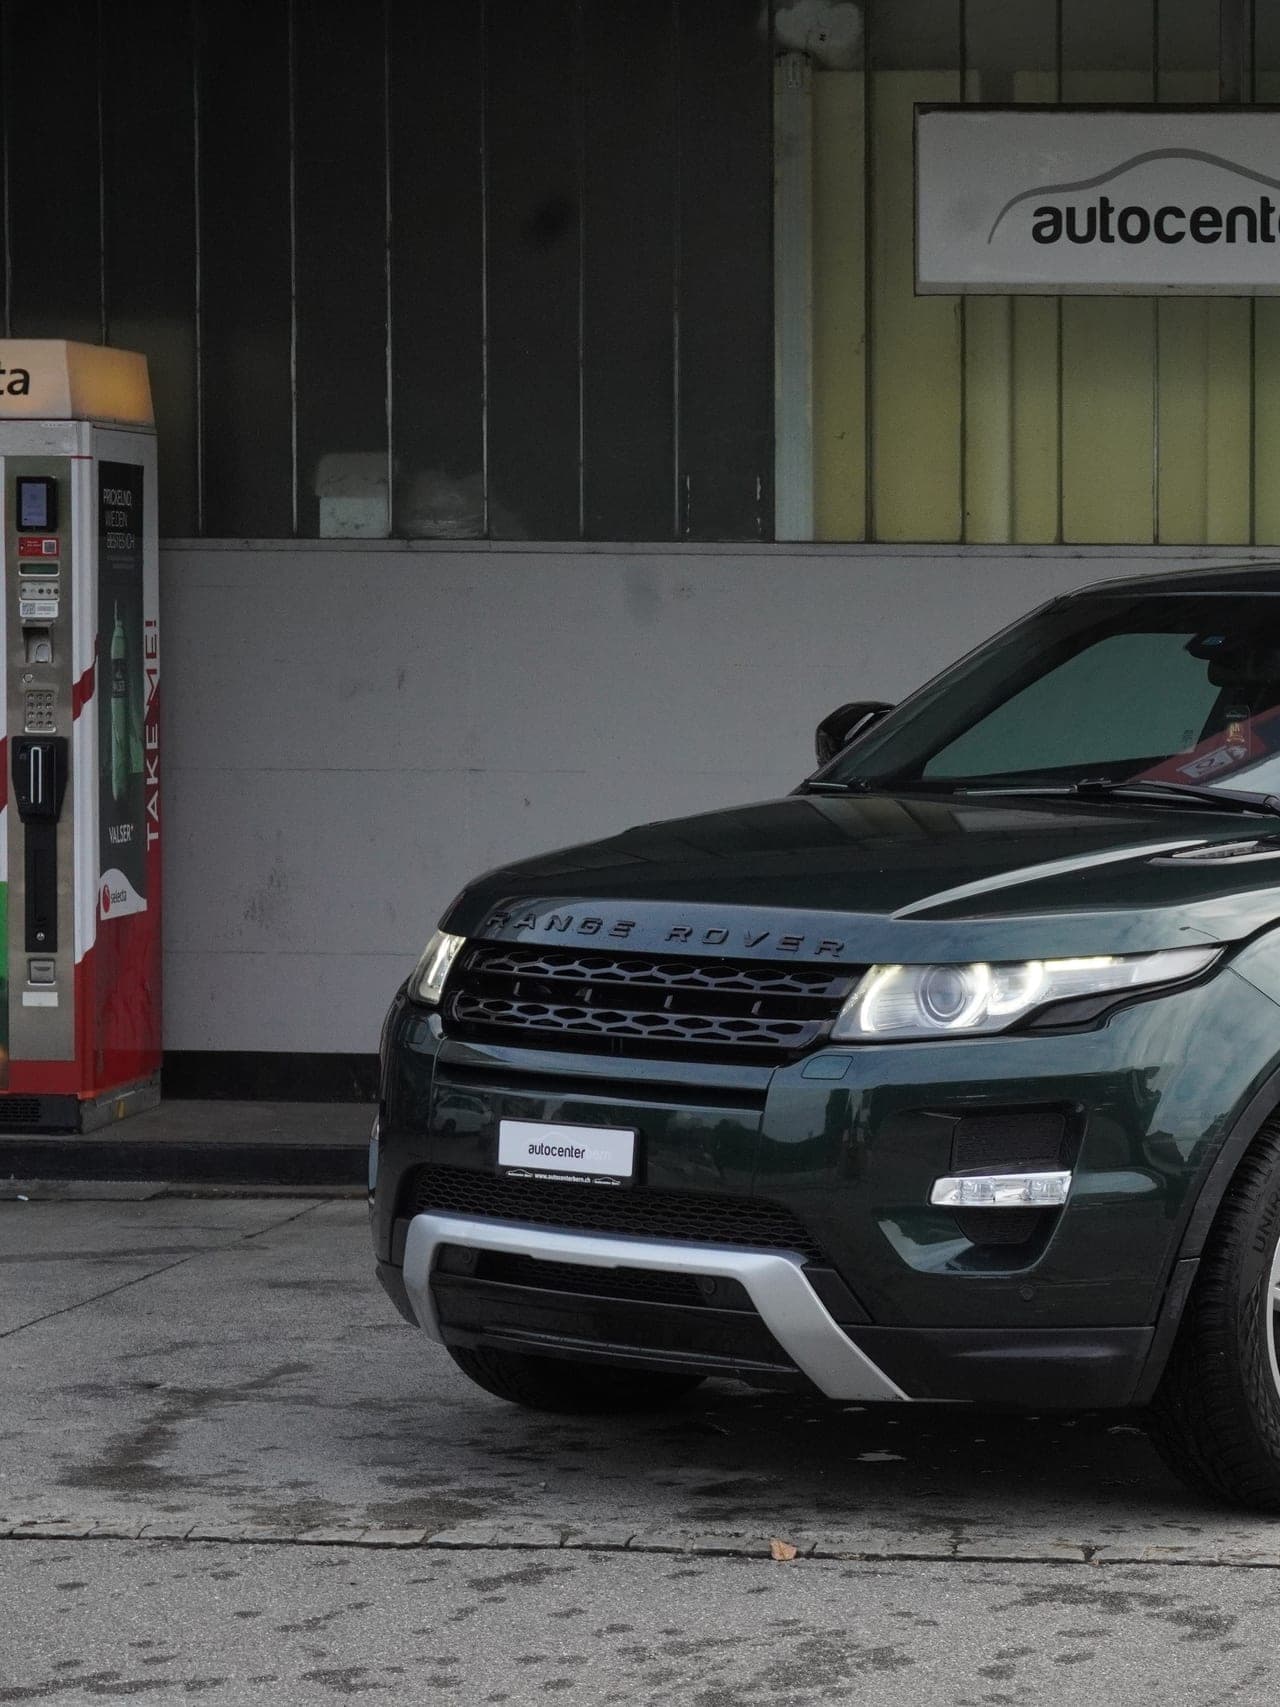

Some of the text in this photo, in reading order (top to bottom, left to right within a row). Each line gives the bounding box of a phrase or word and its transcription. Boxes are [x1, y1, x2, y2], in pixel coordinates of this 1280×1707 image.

[146, 723, 160, 851] TAKE
[486, 911, 845, 957] RANGE ROVER
